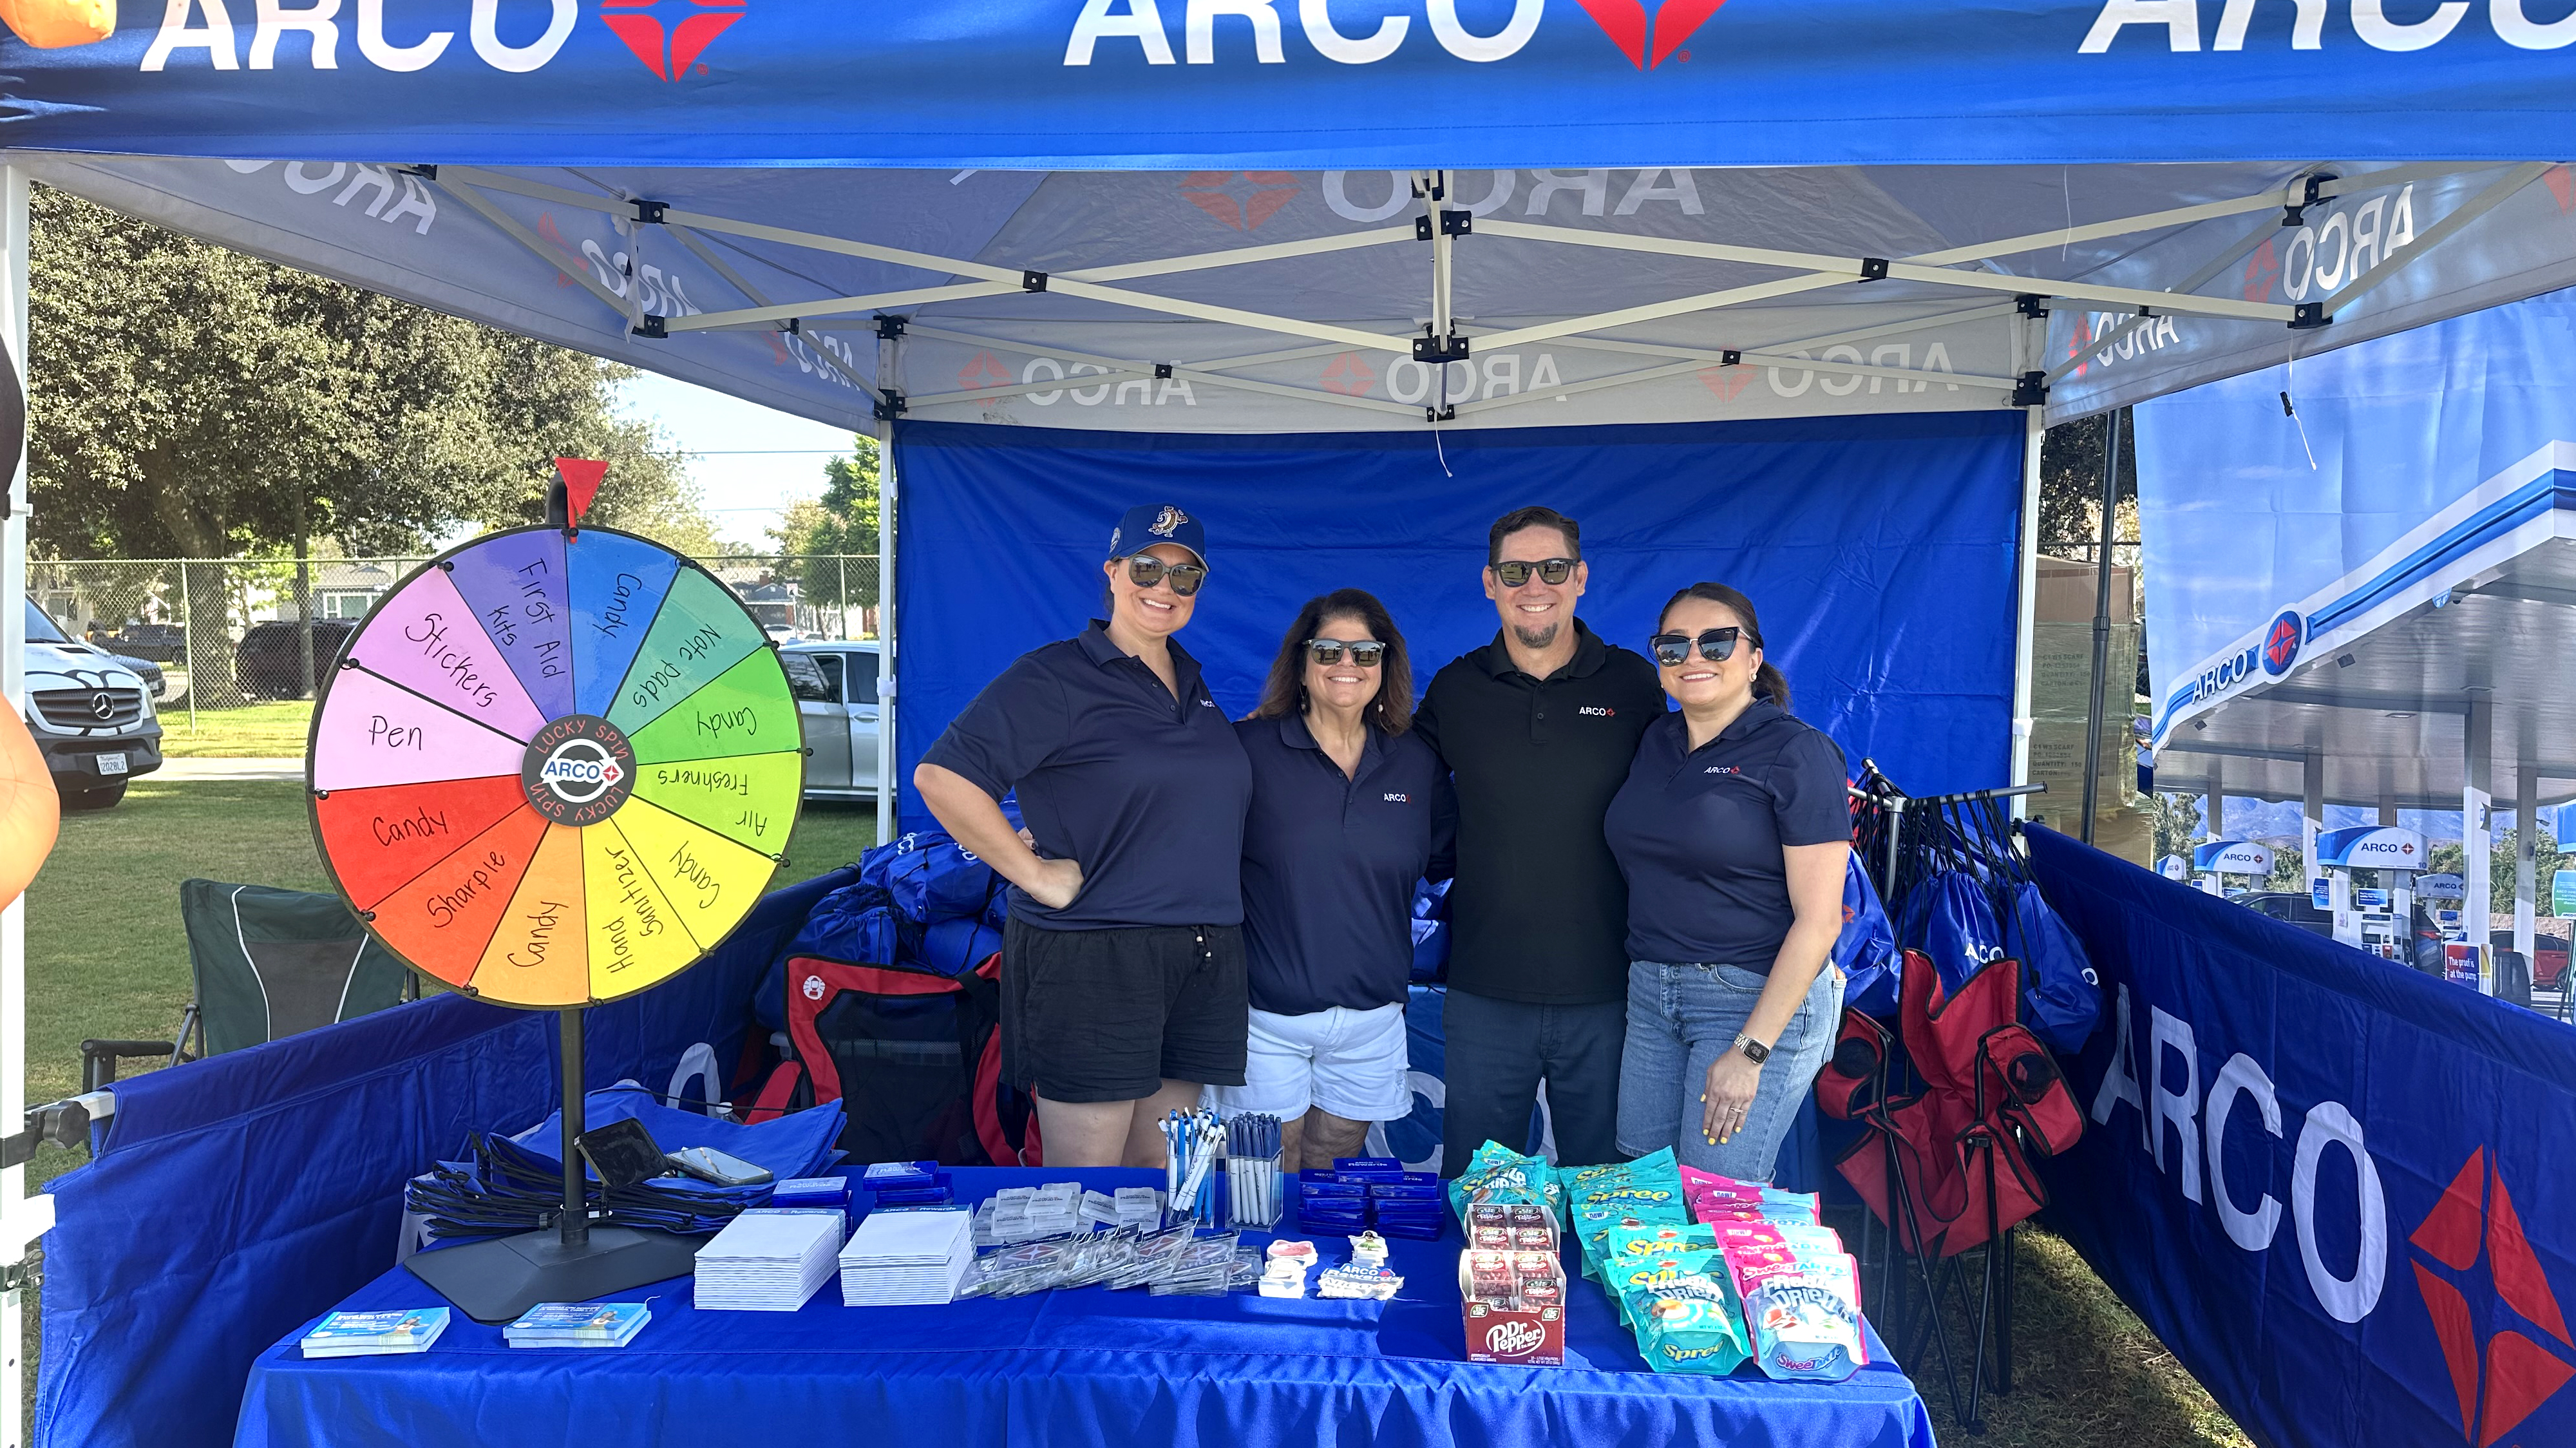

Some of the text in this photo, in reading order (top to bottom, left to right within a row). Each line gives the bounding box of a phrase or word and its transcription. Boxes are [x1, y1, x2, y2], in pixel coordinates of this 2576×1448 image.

[592, 572, 642, 640] Candy
[405, 613, 498, 707] Stickers
[680, 623, 723, 663] Note
[2192, 647, 2248, 705] ARCO
[697, 708, 757, 738] Candy
[1579, 707, 1606, 716] ARCO
[368, 716, 423, 751] Pen
[535, 719, 629, 760] LUCKY SPIN
[545, 761, 600, 779] ARCO
[1704, 766, 1730, 774] ARCO
[529, 782, 625, 821] LUCKY SPIN
[1384, 793, 1406, 803] ARCO
[373, 809, 450, 847] Candy
[2223, 853, 2251, 862] ARCO
[2362, 843, 2398, 853] ARCO
[428, 851, 507, 928] Sharpie
[669, 840, 720, 910] Candy
[507, 900, 569, 967] Candy
[602, 916, 634, 974] Hand
[2448, 956, 2459, 966] The
[2092, 982, 2387, 1324] ARCO
[1341, 1265, 1379, 1276] ARCO
[1486, 1324, 1541, 1353] Pepper
[1506, 1321, 1528, 1338] Dr
